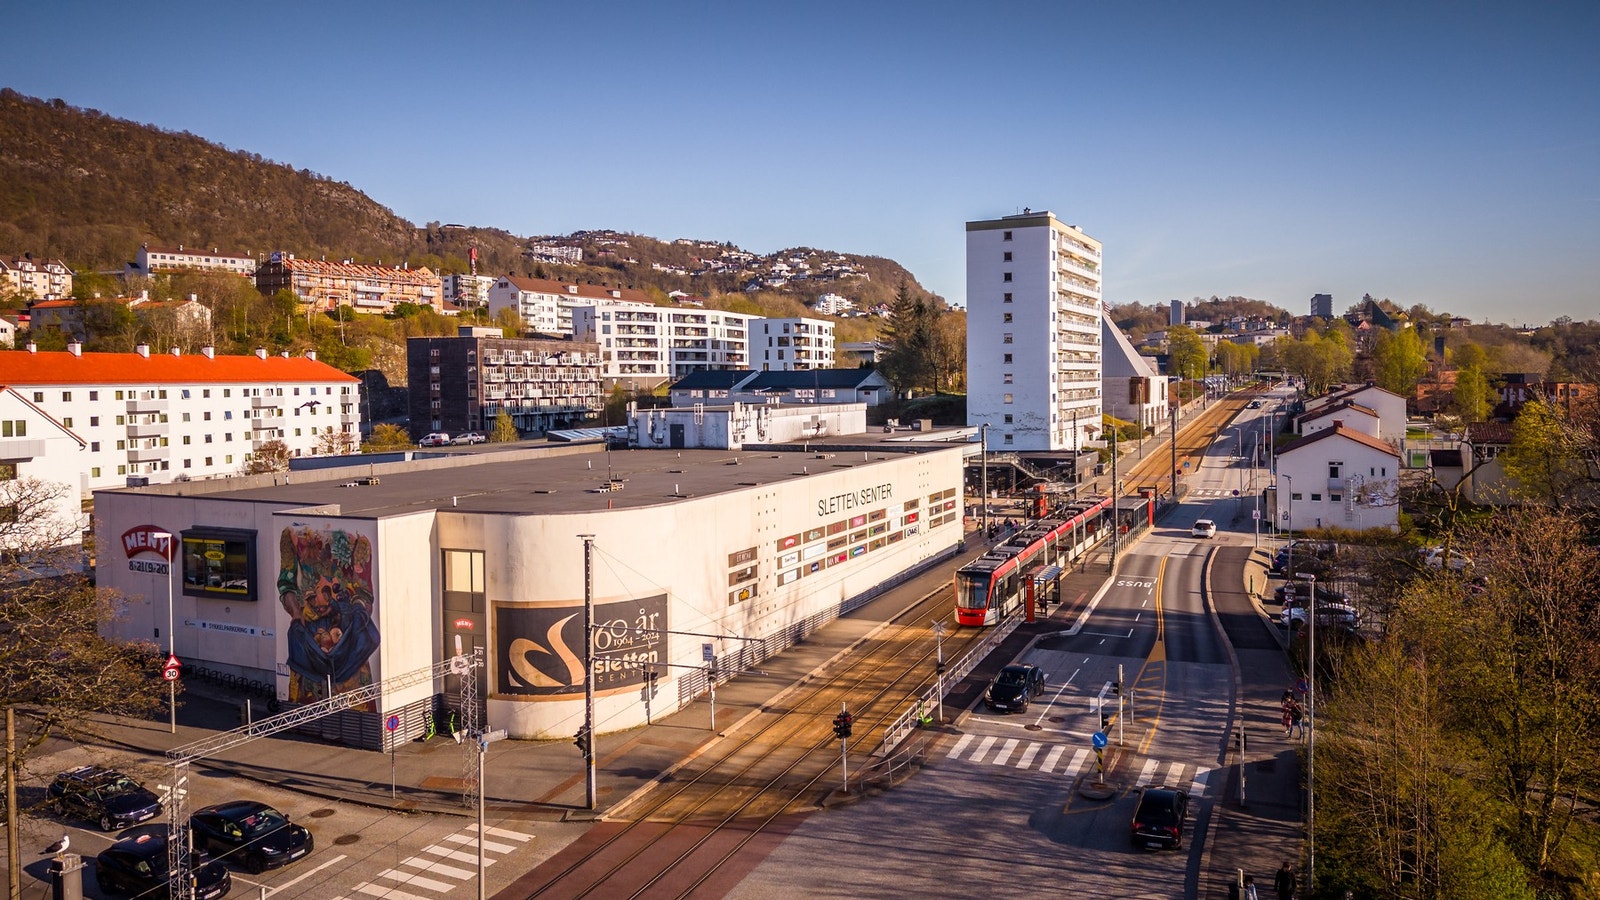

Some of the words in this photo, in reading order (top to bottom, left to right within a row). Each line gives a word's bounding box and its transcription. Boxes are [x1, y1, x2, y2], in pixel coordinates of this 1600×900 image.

[818, 491, 859, 517] SLETTEN
[860, 483, 893, 506] SENTER
[125, 531, 168, 553] MENY
[1116, 580, 1152, 588] BUSS
[208, 623, 248, 634] SYKKELPARKERING
[456, 620, 473, 628] MENY
[594, 619, 628, 650] 60
[635, 608, 660, 635] år
[613, 634, 634, 649] 1964
[642, 632, 660, 642] 2024
[594, 650, 658, 675] sletten
[166, 670, 177, 678] 30
